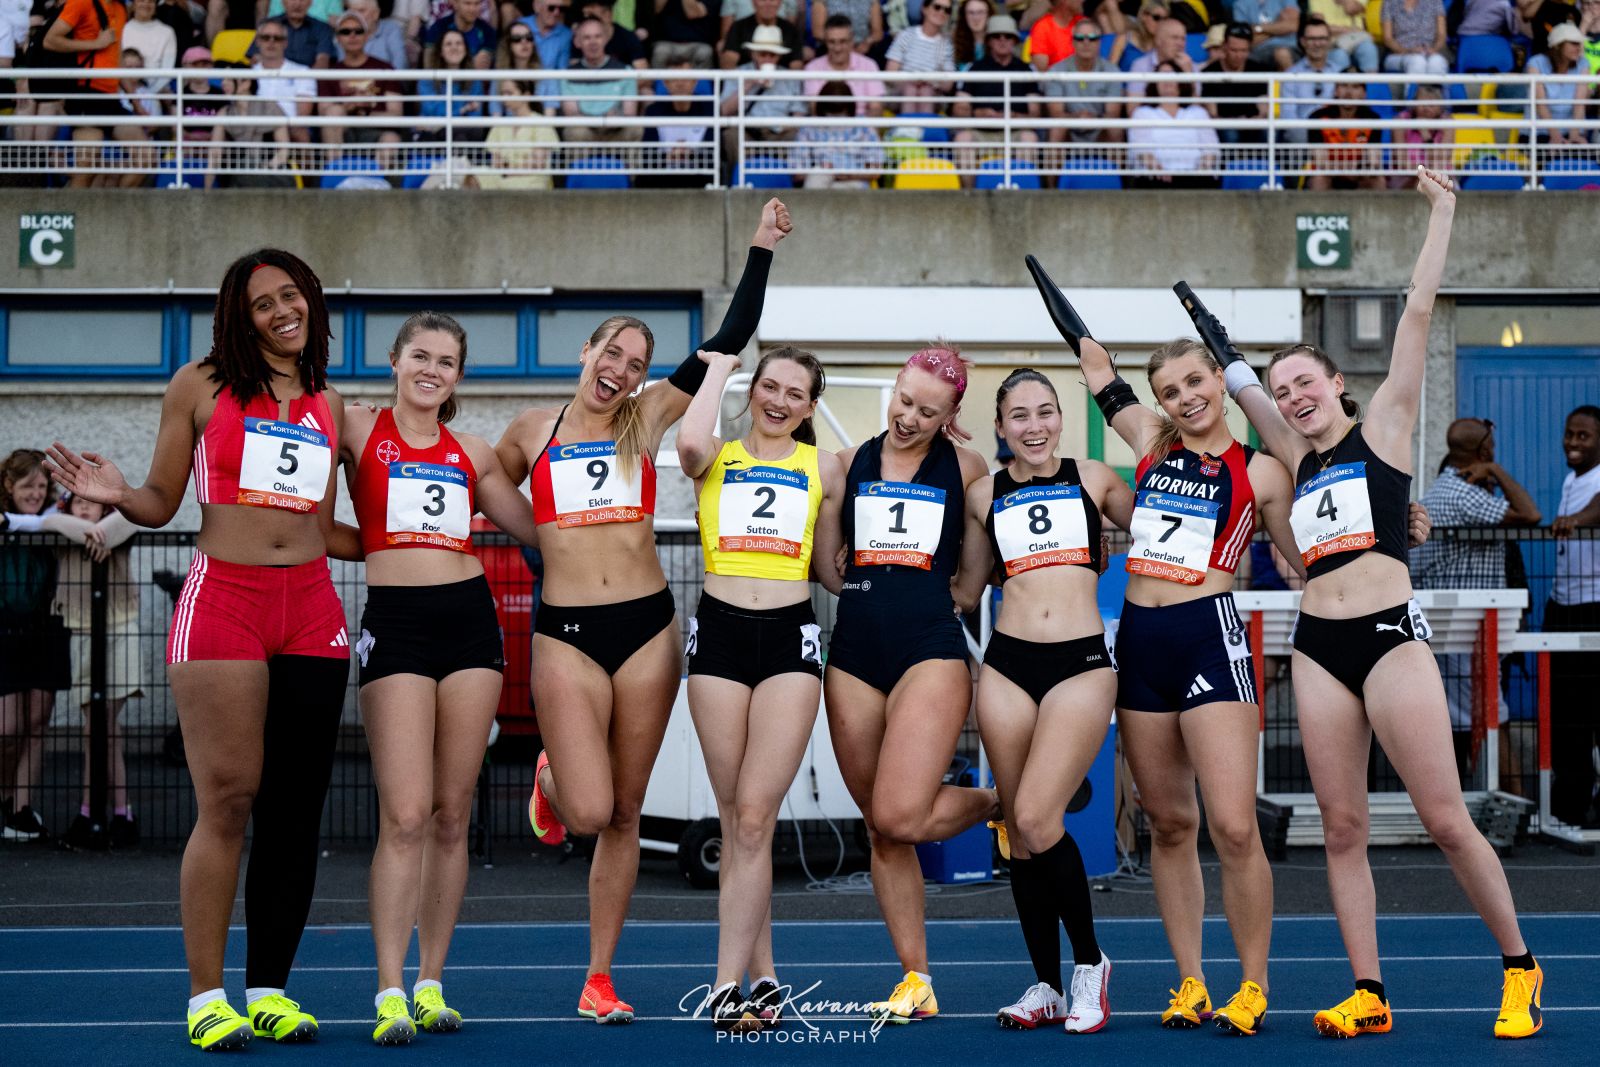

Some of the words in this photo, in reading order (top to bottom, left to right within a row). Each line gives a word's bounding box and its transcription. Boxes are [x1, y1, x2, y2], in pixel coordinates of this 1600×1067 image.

[20, 215, 74, 229] BLOCK
[1296, 216, 1349, 230] BLOCK
[29, 229, 64, 265] C
[1306, 230, 1340, 266] C
[270, 425, 300, 436] MORTON
[300, 431, 320, 444] GAMES
[276, 441, 299, 476] 5
[574, 446, 603, 454] MORTON
[415, 467, 444, 477] MORTON
[445, 471, 464, 481] GAMES
[586, 459, 610, 491] 9
[777, 473, 800, 484] GAMES
[1308, 474, 1330, 487] MORTON
[1330, 468, 1354, 479] GAMES
[273, 482, 298, 494] Okoh
[880, 486, 910, 494] MORTON
[911, 488, 935, 498] GAMES
[1145, 473, 1220, 500] NORWAY
[268, 495, 313, 512] Dublin202
[422, 483, 446, 517] 3
[588, 497, 613, 508] Ekler
[751, 486, 777, 519] 2
[1015, 491, 1045, 501] MORTON
[1156, 497, 1183, 508] MORTON
[1184, 502, 1208, 513] GAMES
[1315, 488, 1338, 522] 4
[586, 509, 638, 522] Dublin2026
[888, 501, 908, 534] 1
[1027, 504, 1052, 535] 8
[746, 525, 779, 536] Sutton
[1157, 514, 1183, 543] 7
[1316, 525, 1348, 543] Grimaldi
[745, 539, 795, 554] Dublin2026
[869, 539, 920, 550] Comerford
[1028, 540, 1060, 553] Clarke
[1317, 536, 1367, 556] Dublin2026
[876, 553, 928, 565] Dublin2026
[1030, 552, 1083, 567] Dublin2026
[1143, 548, 1185, 565] Overland
[1143, 562, 1198, 583] Dublin2026
[1412, 613, 1428, 640] 5
[685, 634, 696, 656] 2
[803, 639, 818, 663] 2
[1353, 1012, 1388, 1028] NITRO
